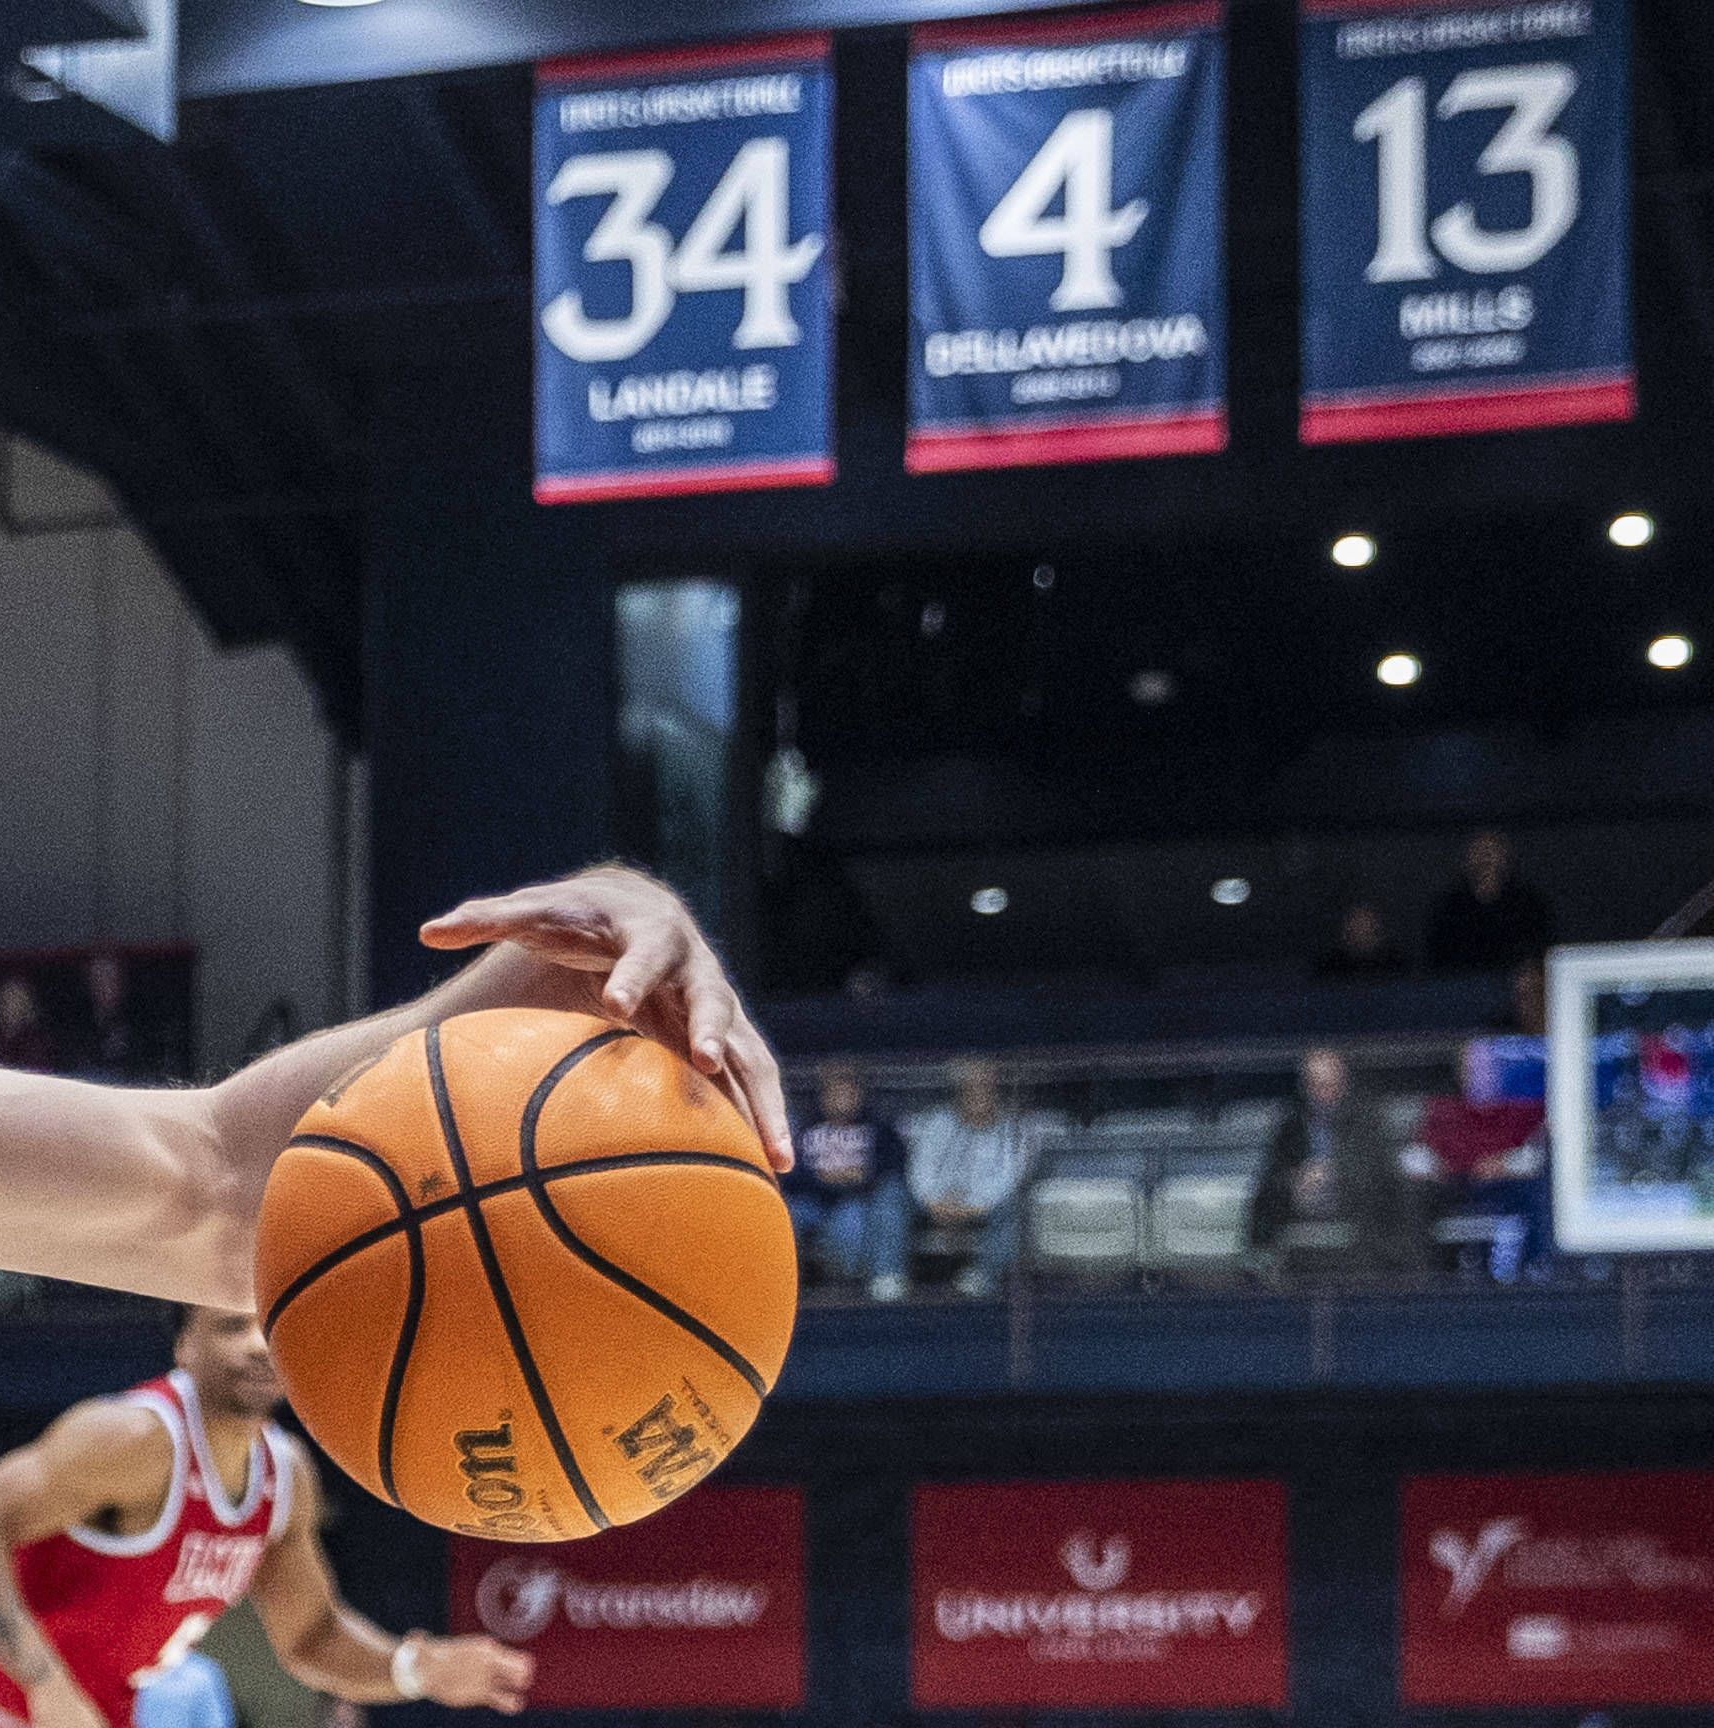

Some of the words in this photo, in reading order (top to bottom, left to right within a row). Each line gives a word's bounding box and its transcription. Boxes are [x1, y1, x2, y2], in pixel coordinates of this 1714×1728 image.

[1352, 62, 1578, 283] 13
[979, 108, 1149, 311] 4
[541, 136, 825, 362] 34
[1400, 284, 1533, 338] MILLS
[924, 315, 1206, 376] DELLAVEDOVA
[589, 365, 777, 421] LANDALE
[933, 1589, 1262, 1640] UNIVERSITY
